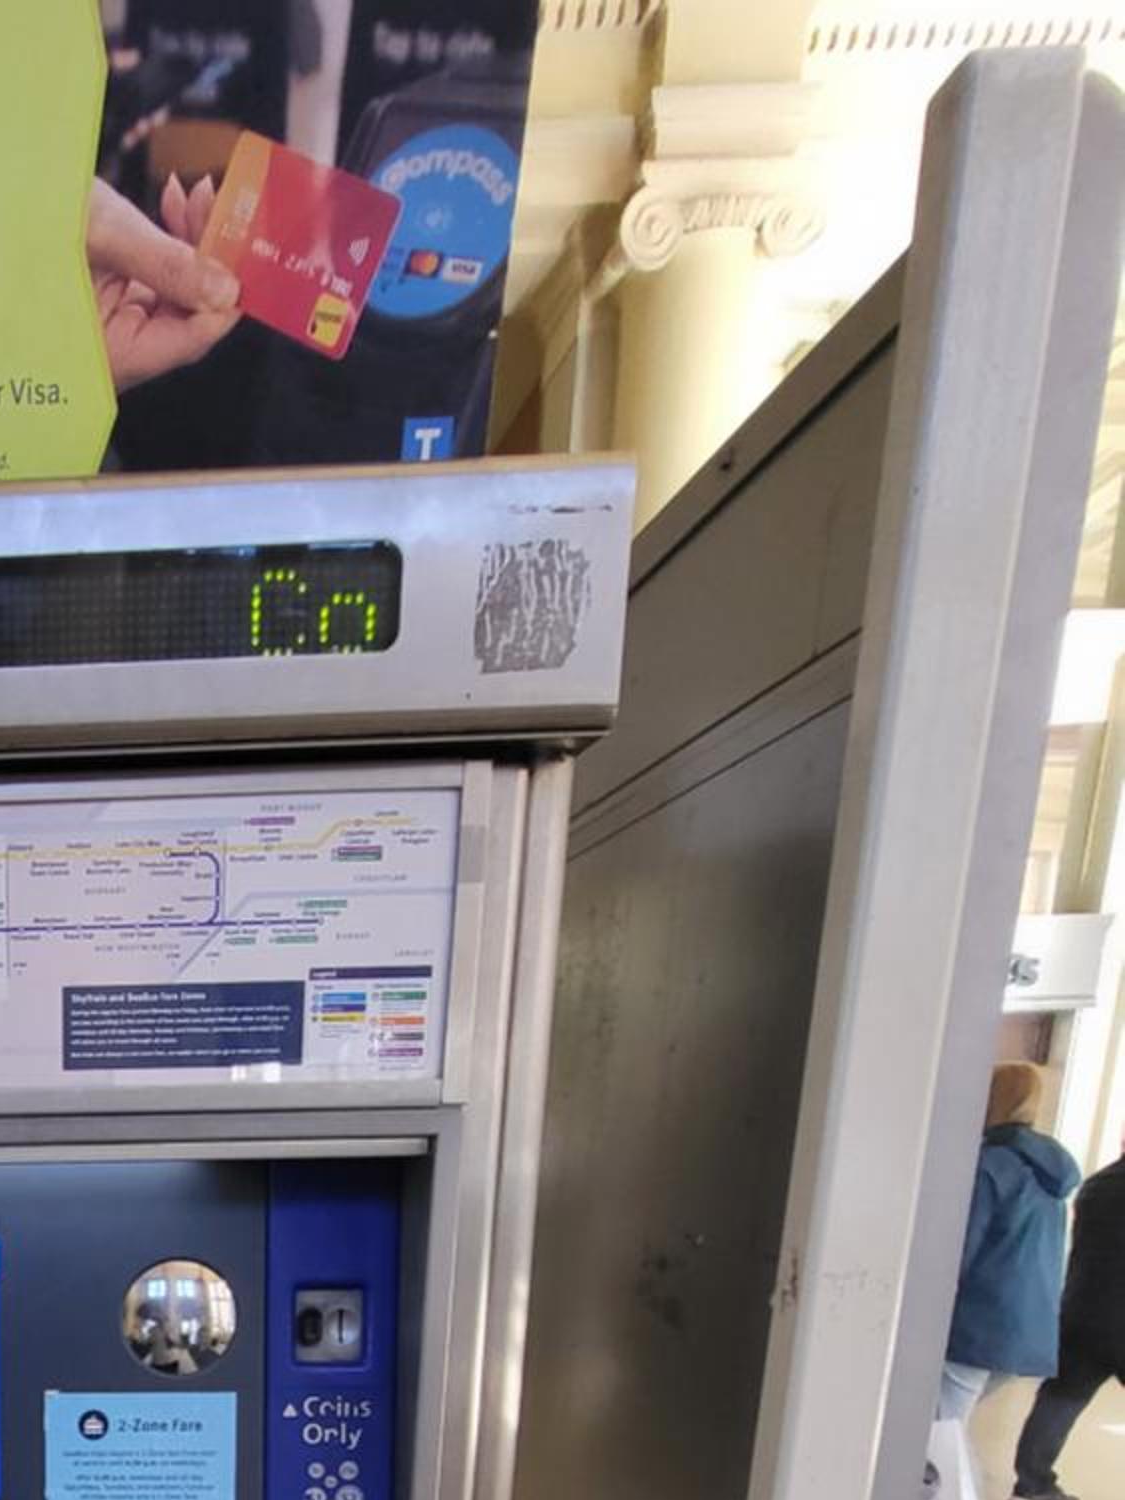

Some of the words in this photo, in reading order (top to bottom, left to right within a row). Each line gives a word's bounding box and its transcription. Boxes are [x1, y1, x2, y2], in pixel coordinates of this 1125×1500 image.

[381, 149, 513, 206] Compass
[9, 378, 69, 407] Visa.
[117, 1419, 168, 1433] 2-Zone
[172, 1419, 203, 1433] Fare
